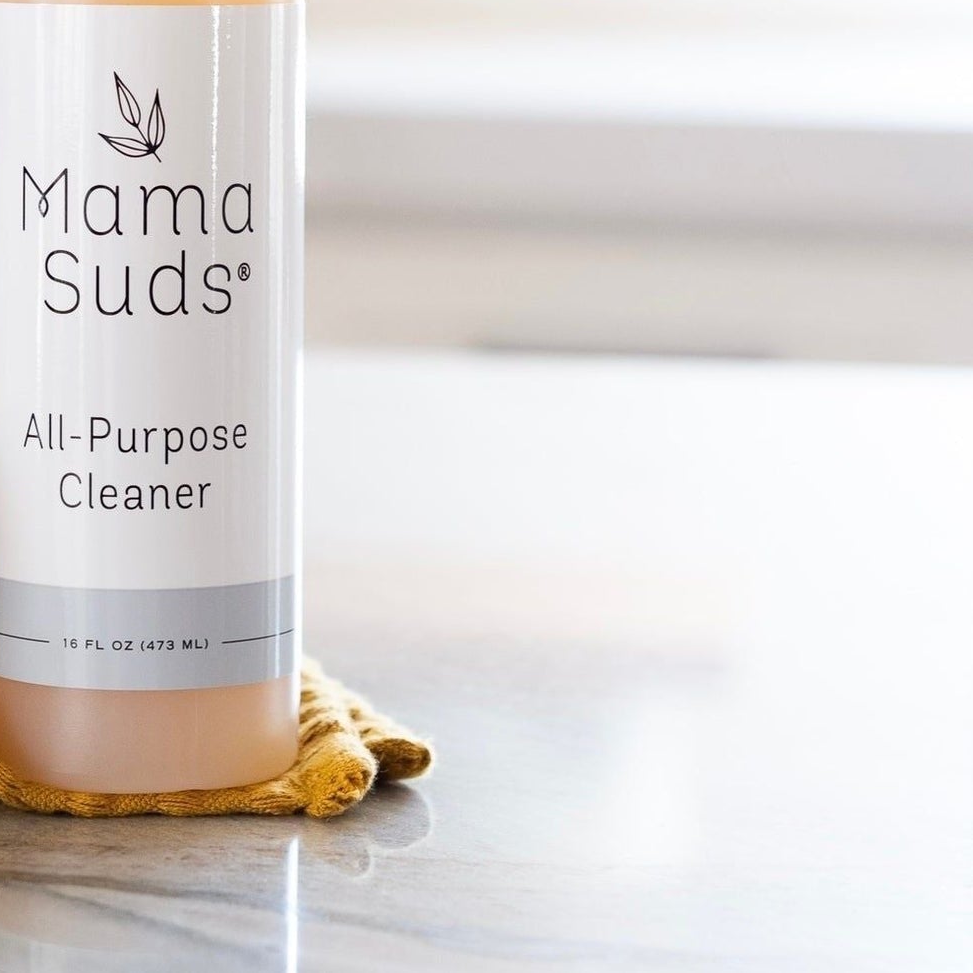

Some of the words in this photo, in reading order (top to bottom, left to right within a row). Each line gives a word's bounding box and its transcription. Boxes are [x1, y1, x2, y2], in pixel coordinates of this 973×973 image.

[22, 165, 255, 236] Mama
[23, 412, 248, 466] All-Purpose
[59, 471, 212, 511] Cleaner
[62, 637, 78, 650] 16
[84, 639, 105, 651] FL
[111, 640, 134, 652] OZ
[140, 640, 175, 652] (473
[181, 638, 209, 651] ML)
